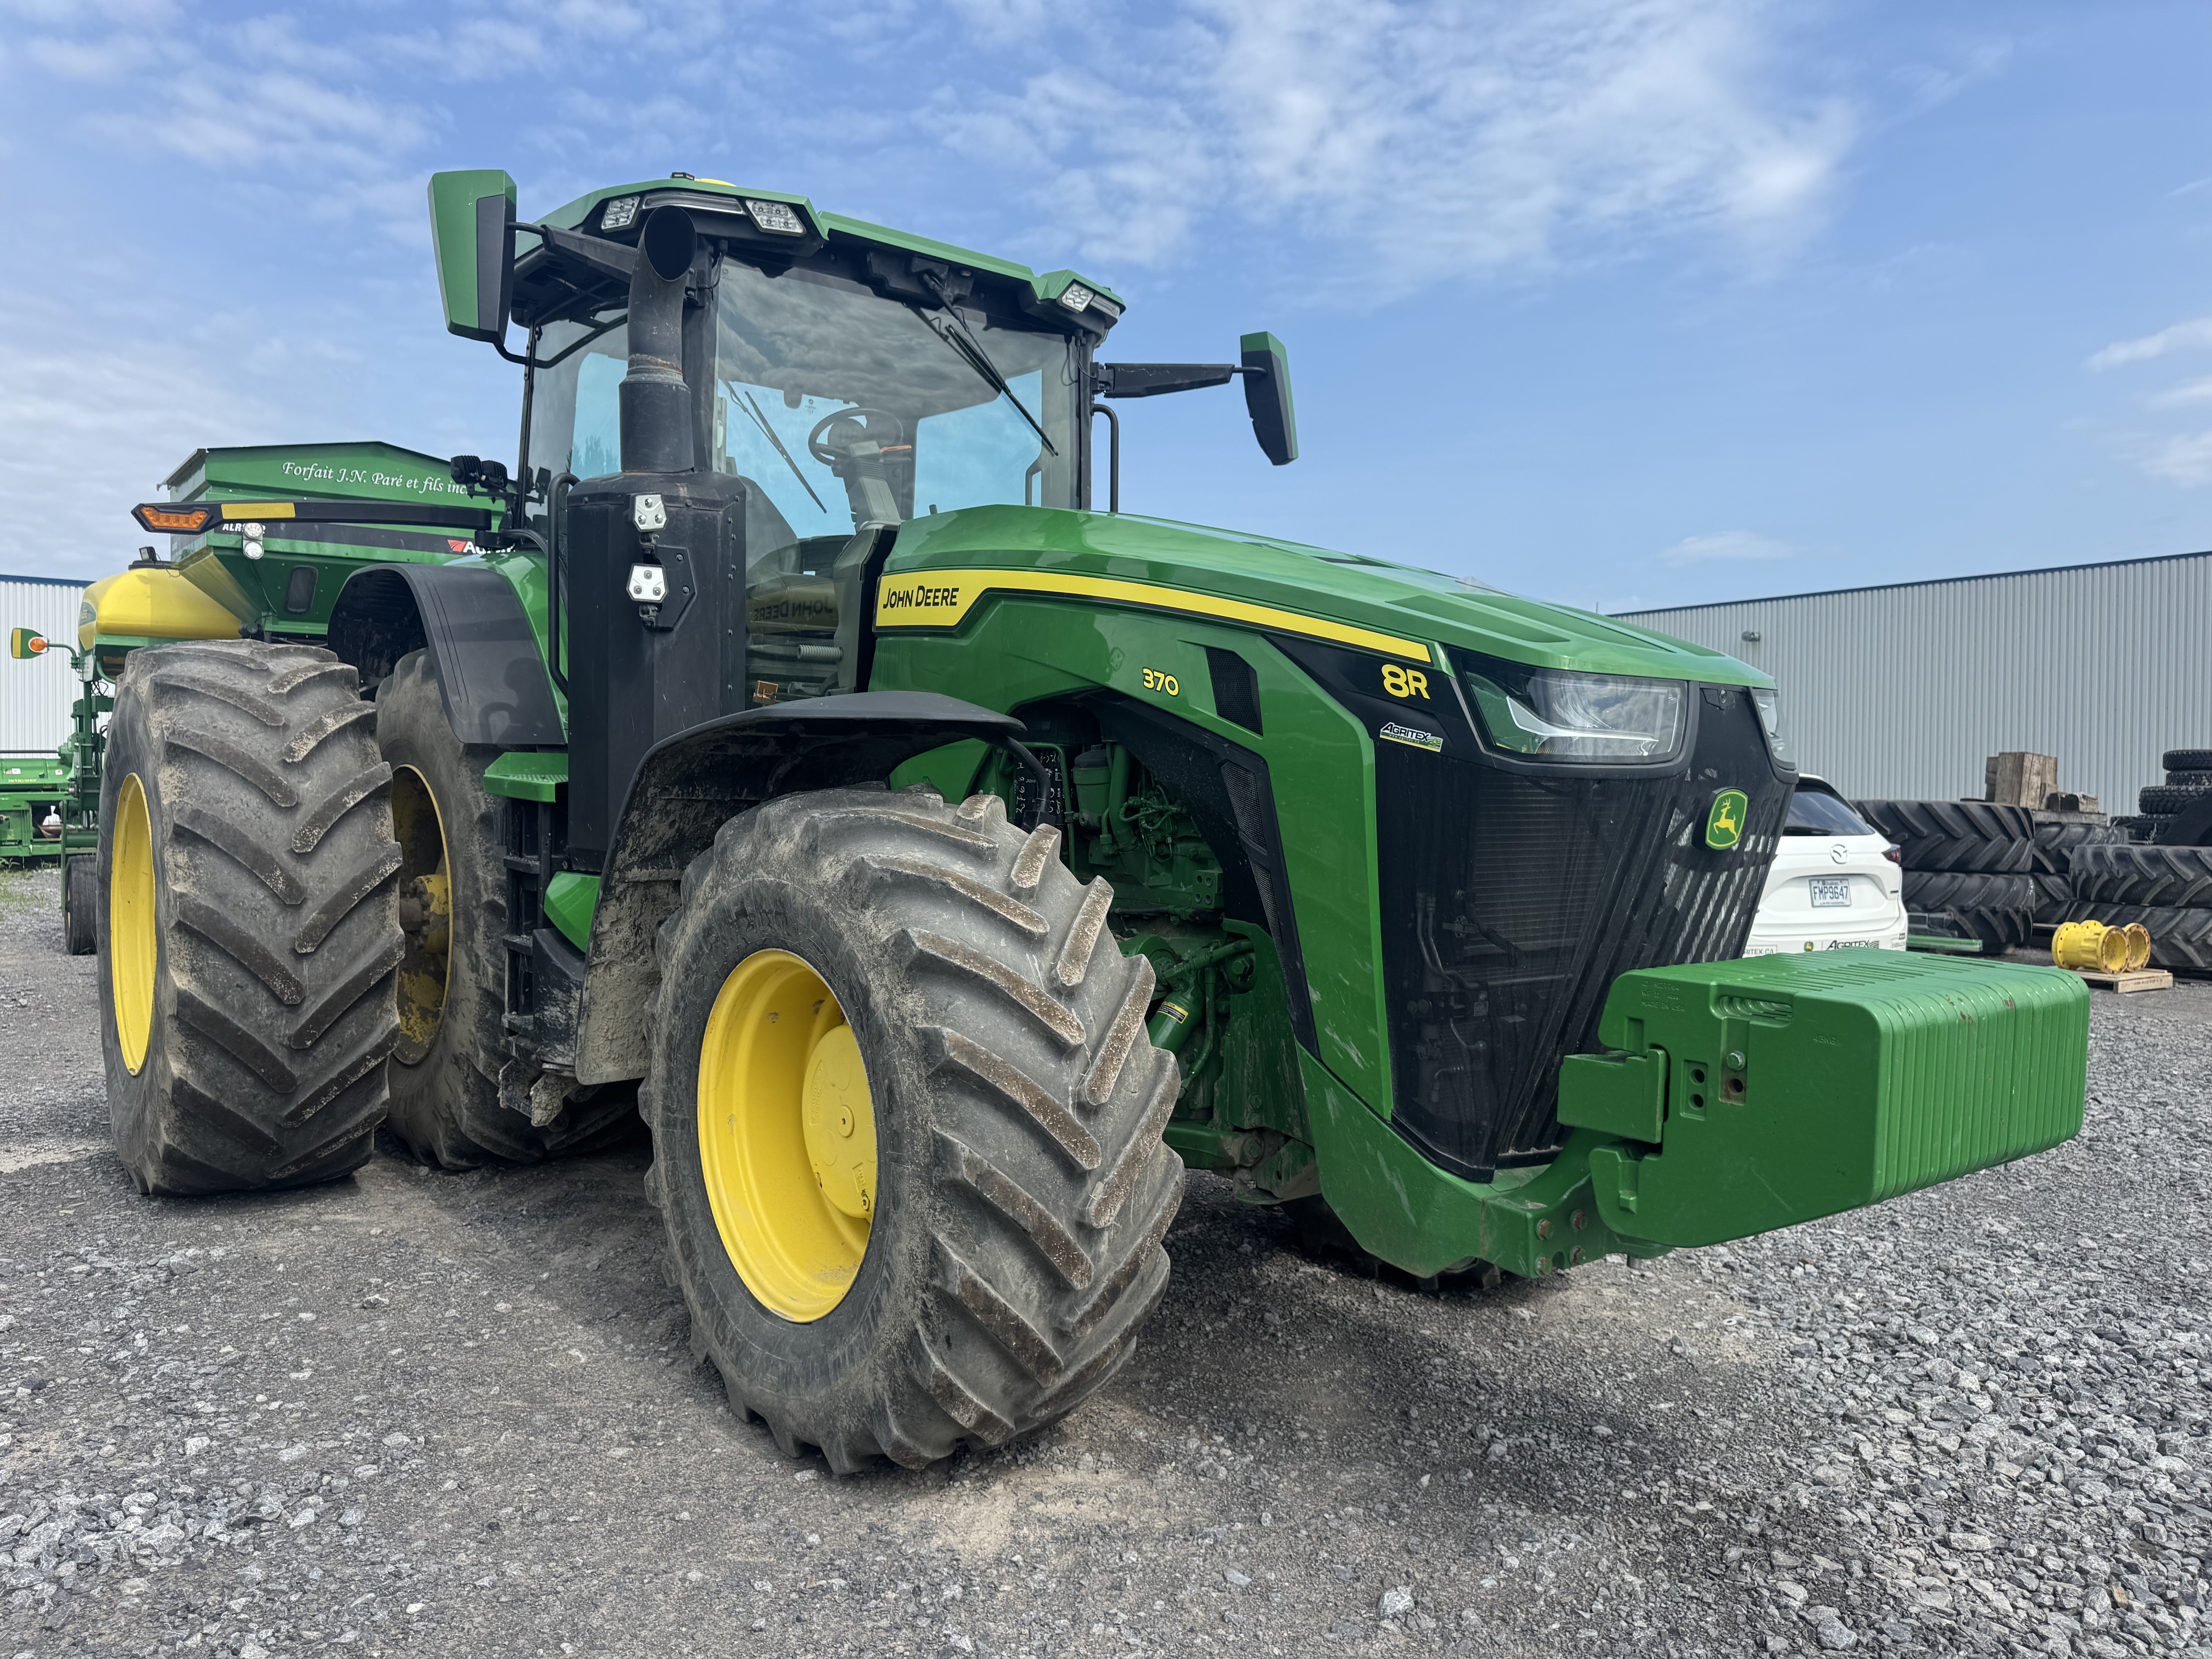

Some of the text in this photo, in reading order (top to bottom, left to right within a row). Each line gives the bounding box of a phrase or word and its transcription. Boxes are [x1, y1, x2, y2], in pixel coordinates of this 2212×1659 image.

[282, 462, 333, 481] Forfait
[337, 469, 367, 483] J.N.
[372, 472, 402, 487] Paré
[406, 479, 419, 489] et
[419, 477, 444, 494] fils
[883, 586, 959, 609] JOHN DEERE
[1143, 668, 1179, 696] 370
[1382, 664, 1431, 699] 8R
[1382, 723, 1429, 742] AGRITEX
[1813, 886, 1848, 900] FMP9647
